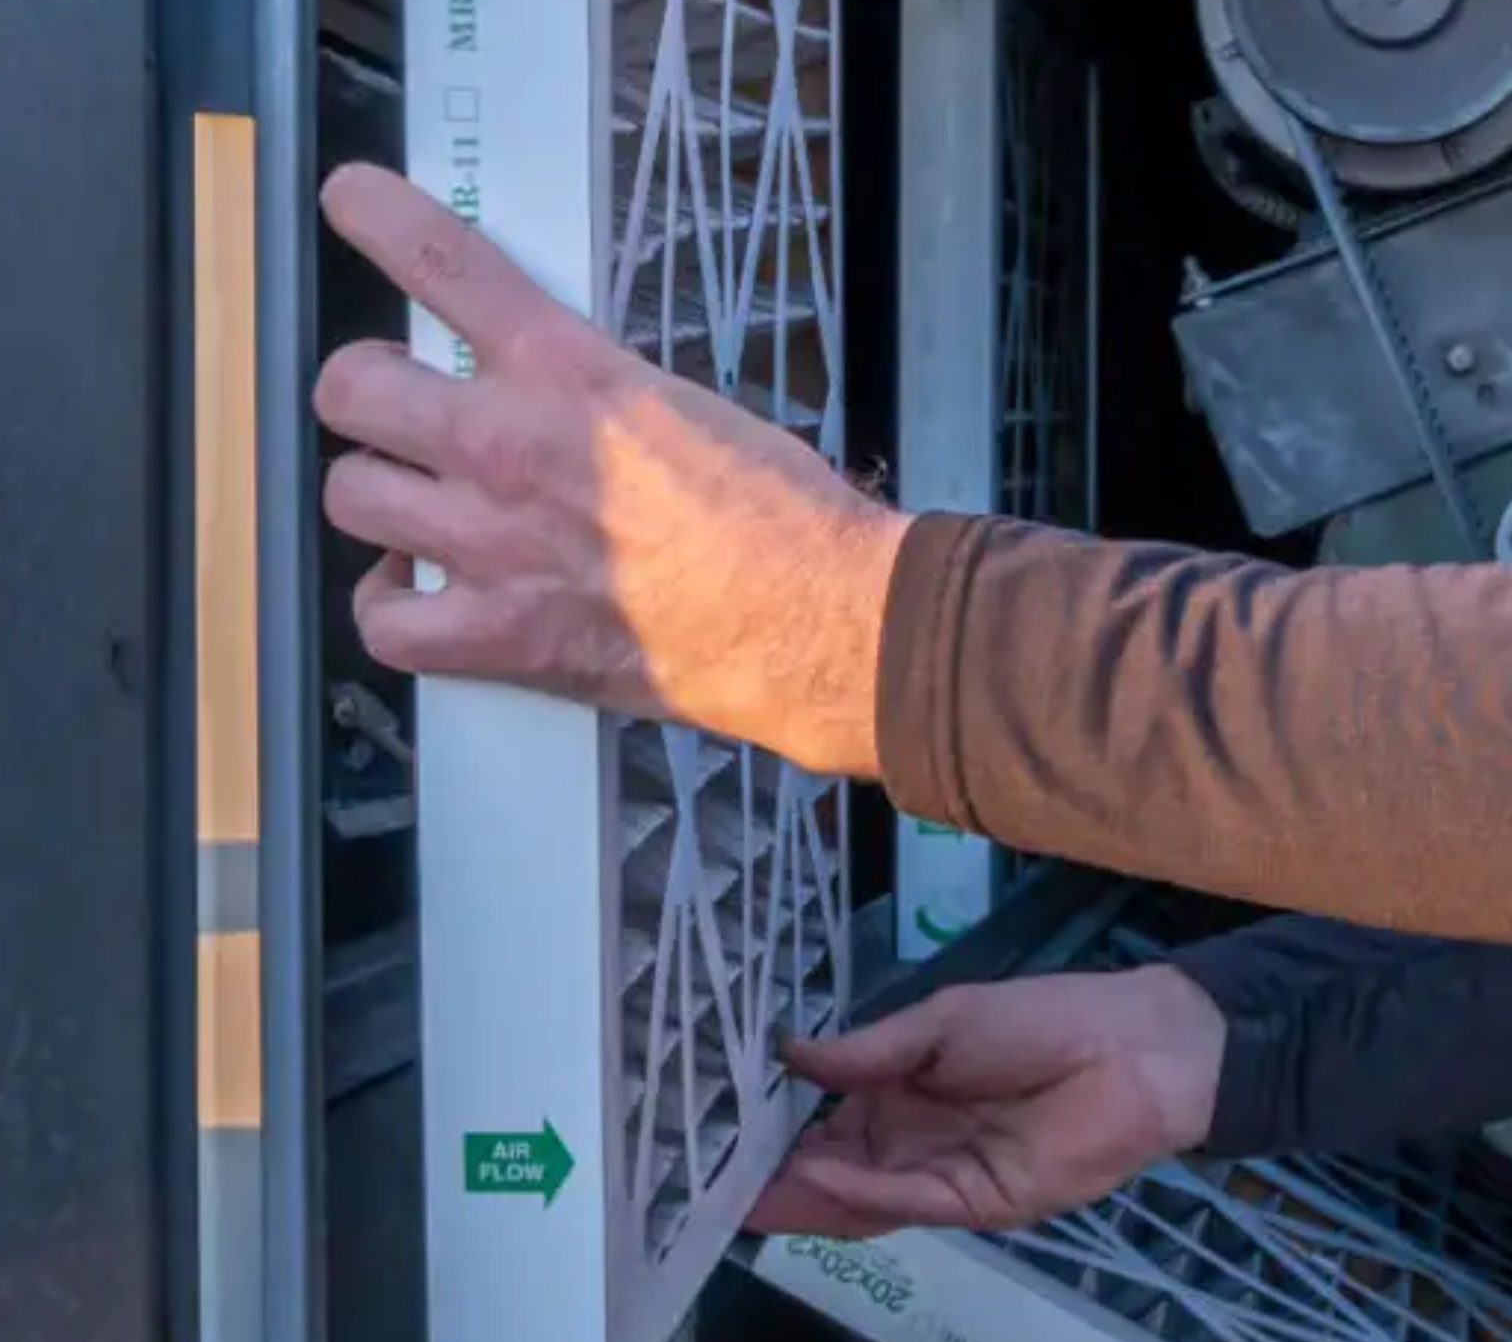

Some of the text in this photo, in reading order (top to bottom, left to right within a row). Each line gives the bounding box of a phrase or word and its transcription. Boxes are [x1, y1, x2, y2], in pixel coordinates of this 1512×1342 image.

[449, 137, 479, 229] R-11
[492, 1141, 530, 1160] AIR
[479, 1163, 545, 1181] FLOW
